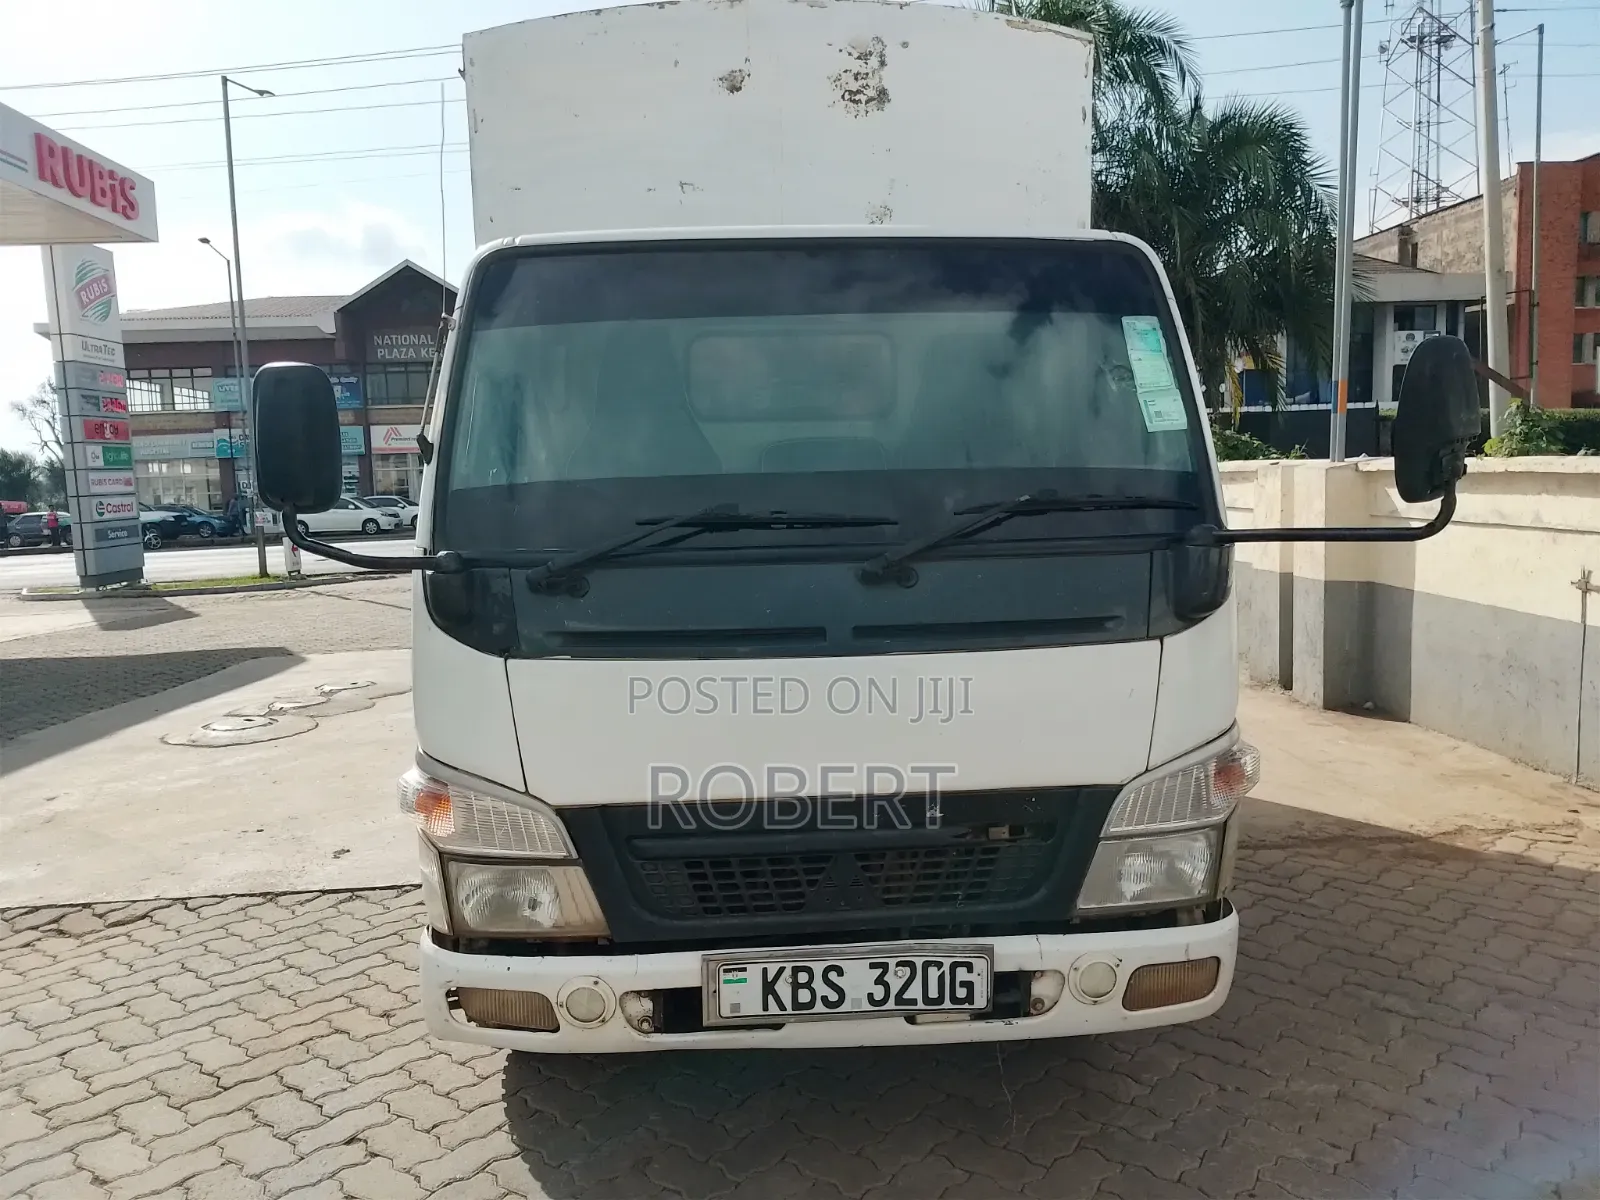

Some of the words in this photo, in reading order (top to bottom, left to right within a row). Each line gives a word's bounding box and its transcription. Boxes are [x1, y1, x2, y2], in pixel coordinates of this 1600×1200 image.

[374, 335, 434, 345] NATIONAL
[378, 348, 416, 359] PLAZA
[106, 501, 134, 513] Castrol
[108, 528, 128, 538] Service
[761, 964, 846, 1012] KBS
[866, 959, 975, 1008] 320G
